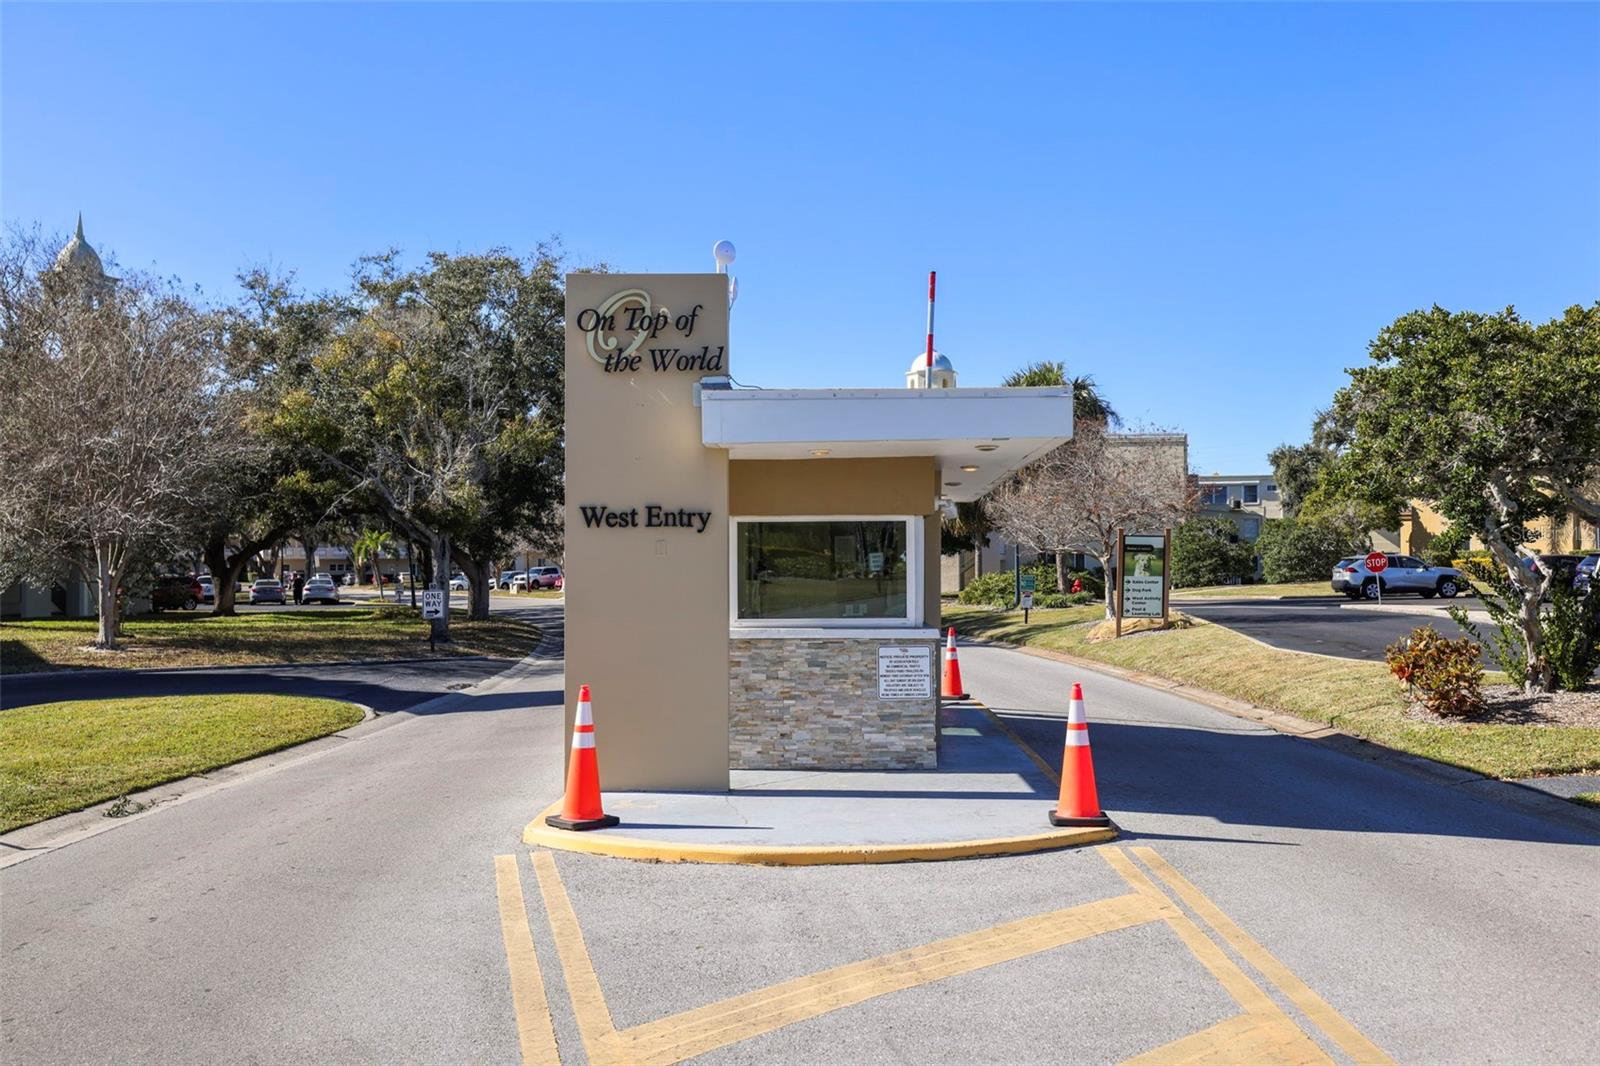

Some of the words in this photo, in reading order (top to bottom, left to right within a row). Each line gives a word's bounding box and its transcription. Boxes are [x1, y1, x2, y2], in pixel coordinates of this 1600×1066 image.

[577, 308, 616, 332] On
[624, 306, 669, 339] Top
[675, 304, 703, 338] of
[604, 347, 642, 374] the
[650, 346, 725, 373] World
[579, 506, 639, 528] West
[645, 505, 712, 533] Entry
[1366, 557, 1386, 568] STOP
